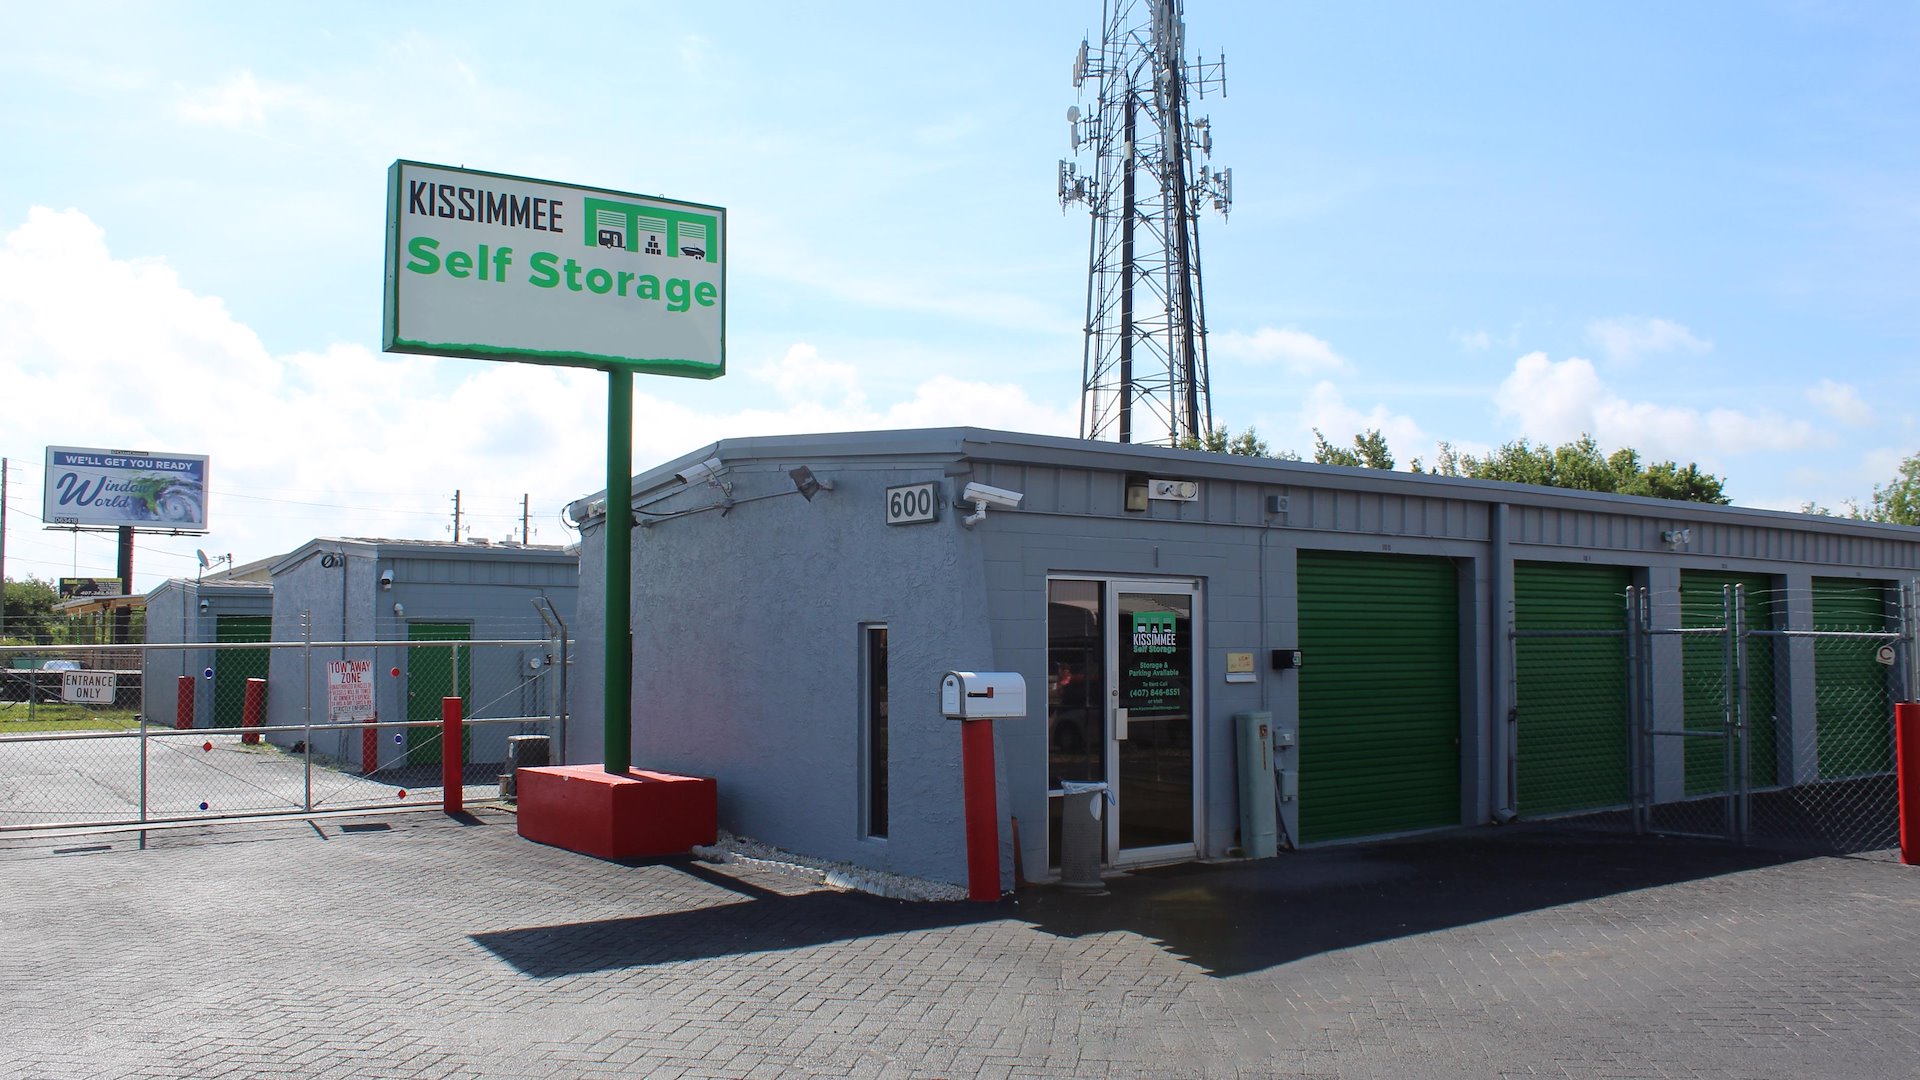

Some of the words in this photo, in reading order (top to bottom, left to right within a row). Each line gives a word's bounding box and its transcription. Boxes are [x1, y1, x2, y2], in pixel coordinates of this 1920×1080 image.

[409, 180, 564, 233] KISSIMMEE
[406, 236, 513, 283] Self
[528, 251, 718, 313] Storage
[66, 455, 101, 465] WE'LL
[105, 457, 126, 467] GET
[130, 459, 153, 468] YOU
[156, 461, 193, 471] READY
[56, 472, 149, 507] Window
[890, 488, 931, 518] 600
[1133, 633, 1176, 646] KISSIMMEE
[1133, 645, 1148, 653] Self
[1149, 645, 1177, 654] Storage
[330, 662, 347, 674] TOW
[351, 661, 371, 673] AWAY
[1140, 662, 1163, 670] Storage
[341, 672, 362, 684] ZONE
[1129, 669, 1151, 677] Parking
[1152, 669, 1179, 677] Available
[66, 674, 113, 687] ENTRANCE
[76, 687, 101, 699] ONLY
[1130, 689, 1149, 698] (407)
